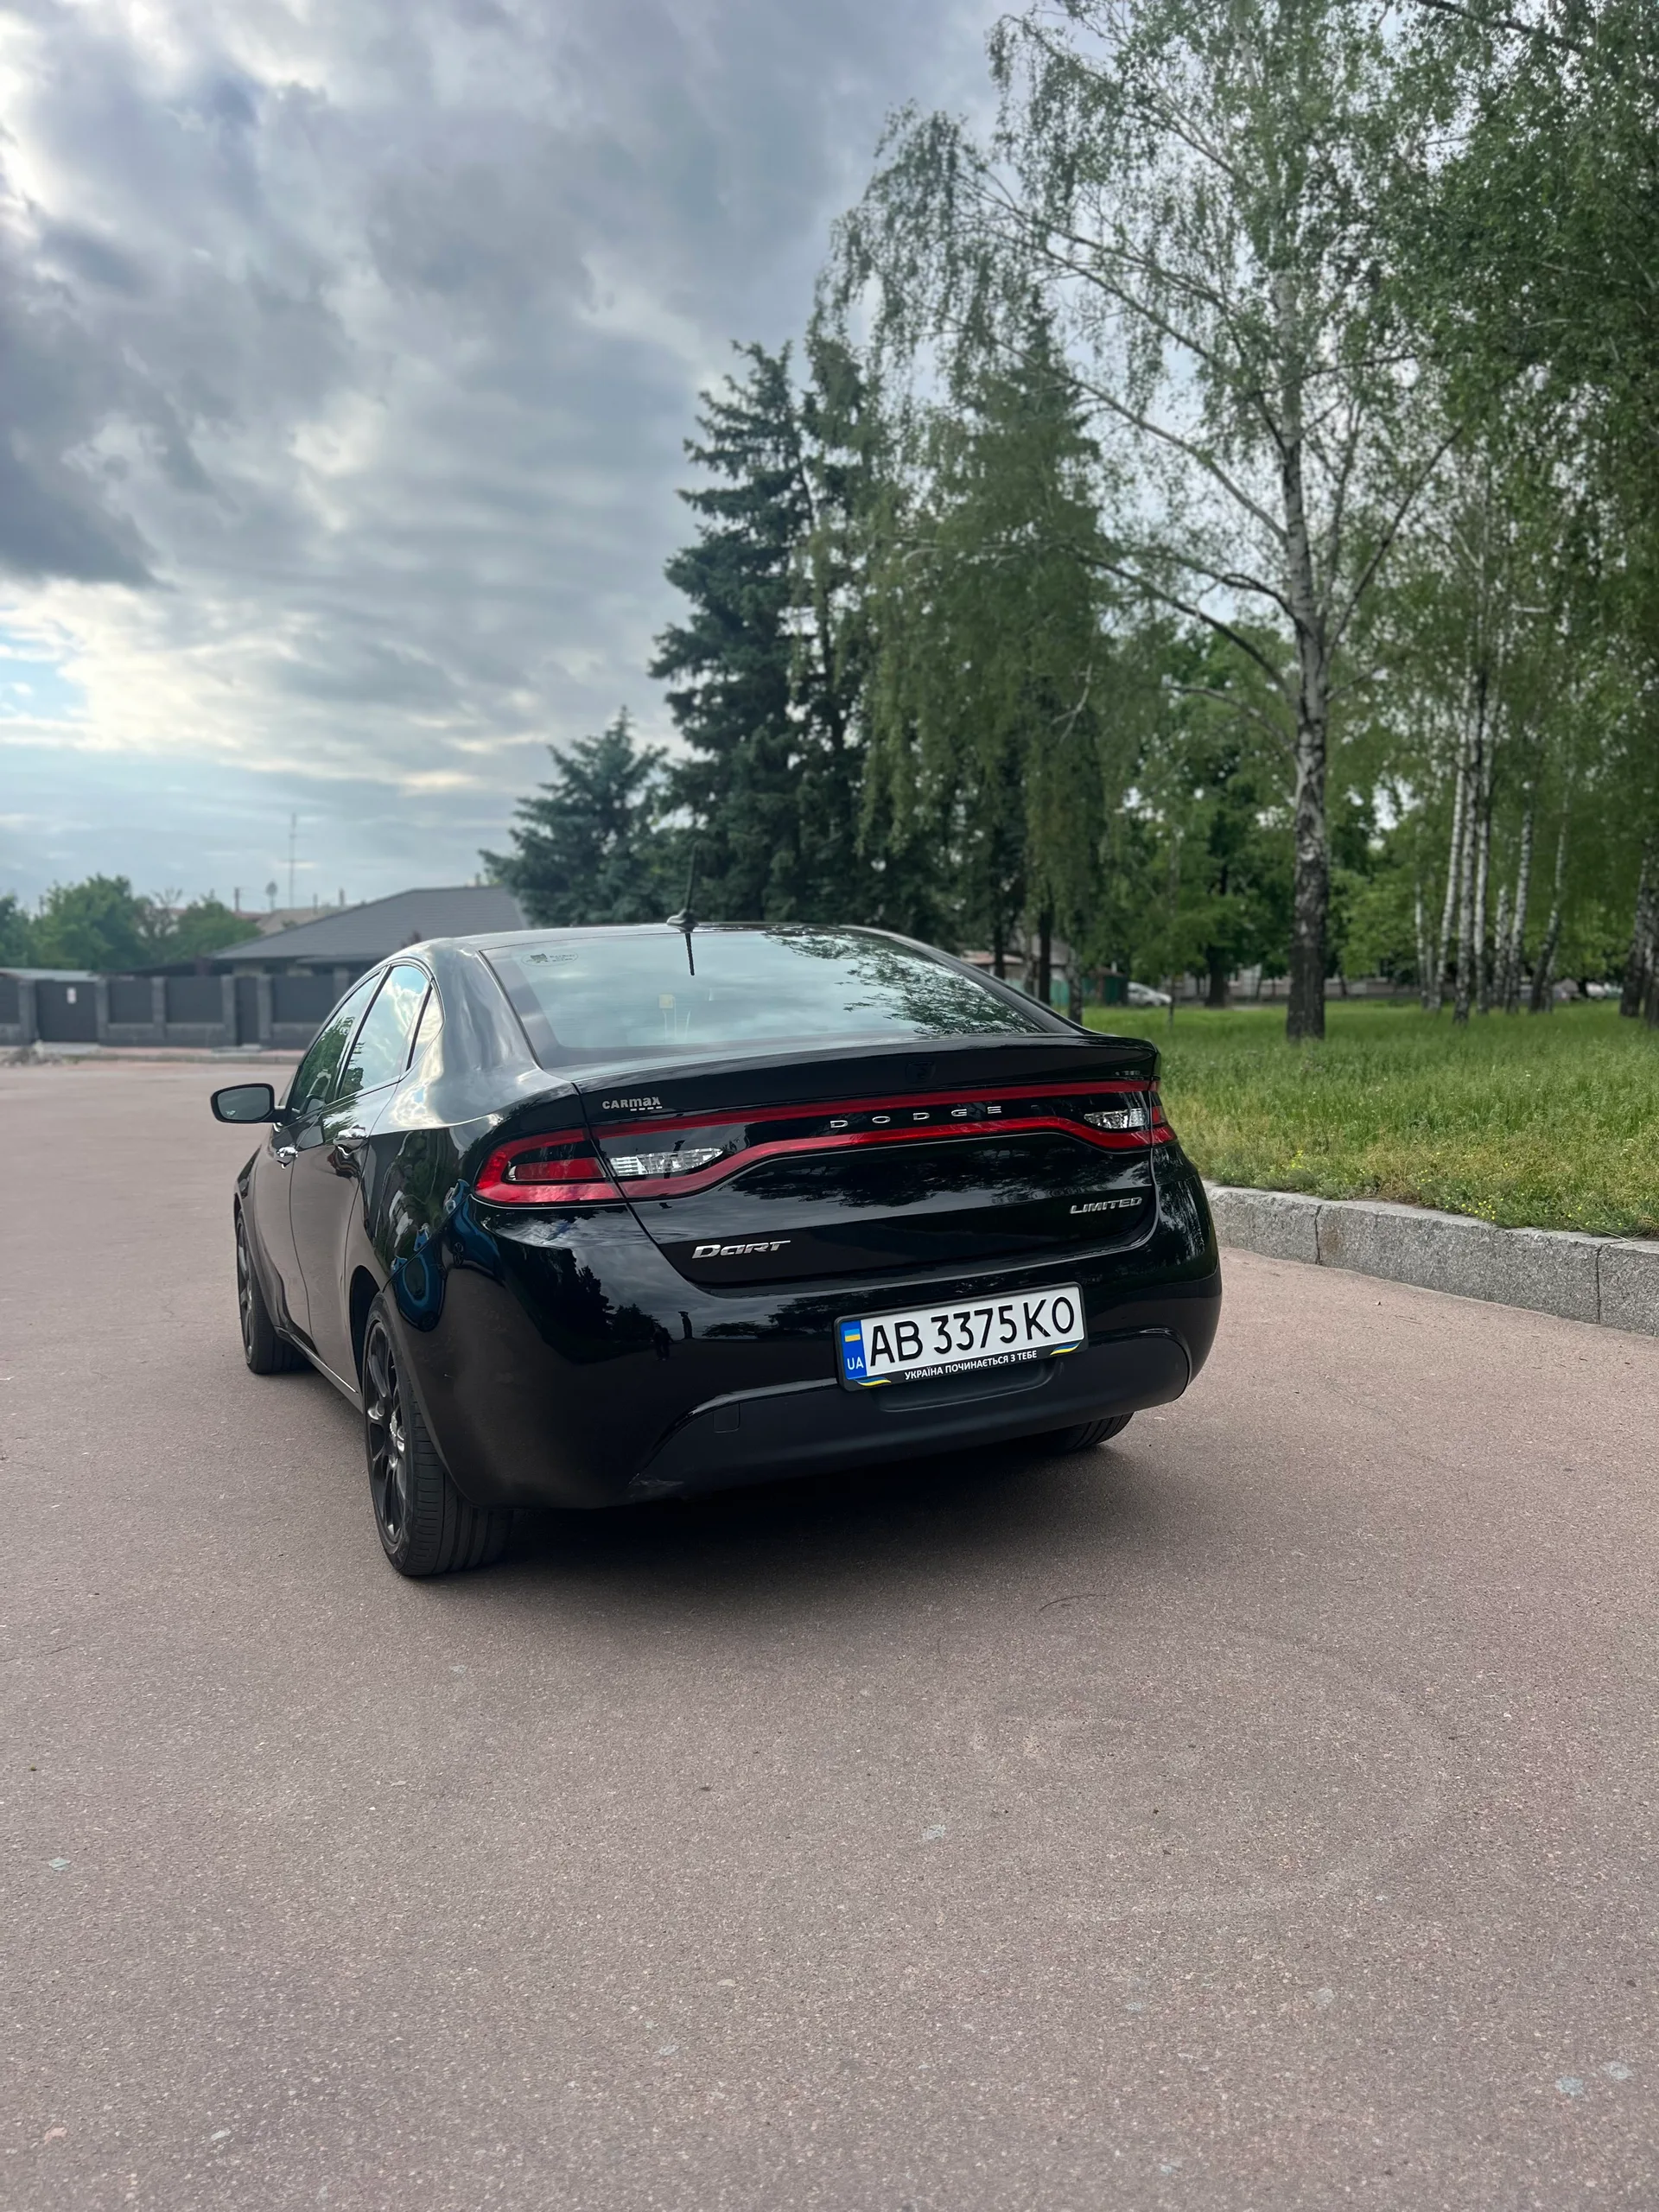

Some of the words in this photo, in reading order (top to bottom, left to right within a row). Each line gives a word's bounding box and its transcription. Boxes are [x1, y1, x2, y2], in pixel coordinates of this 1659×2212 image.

[830, 1106, 1002, 1128] DODGE
[1070, 1197, 1142, 1214] LIMITED
[847, 1358, 864, 1370] UA
[905, 1366, 944, 1381] УКРАЇНА
[945, 1355, 1008, 1372] ПОЧИНАЄТЬСЯ
[1017, 1350, 1038, 1360] ТЕБЕ
